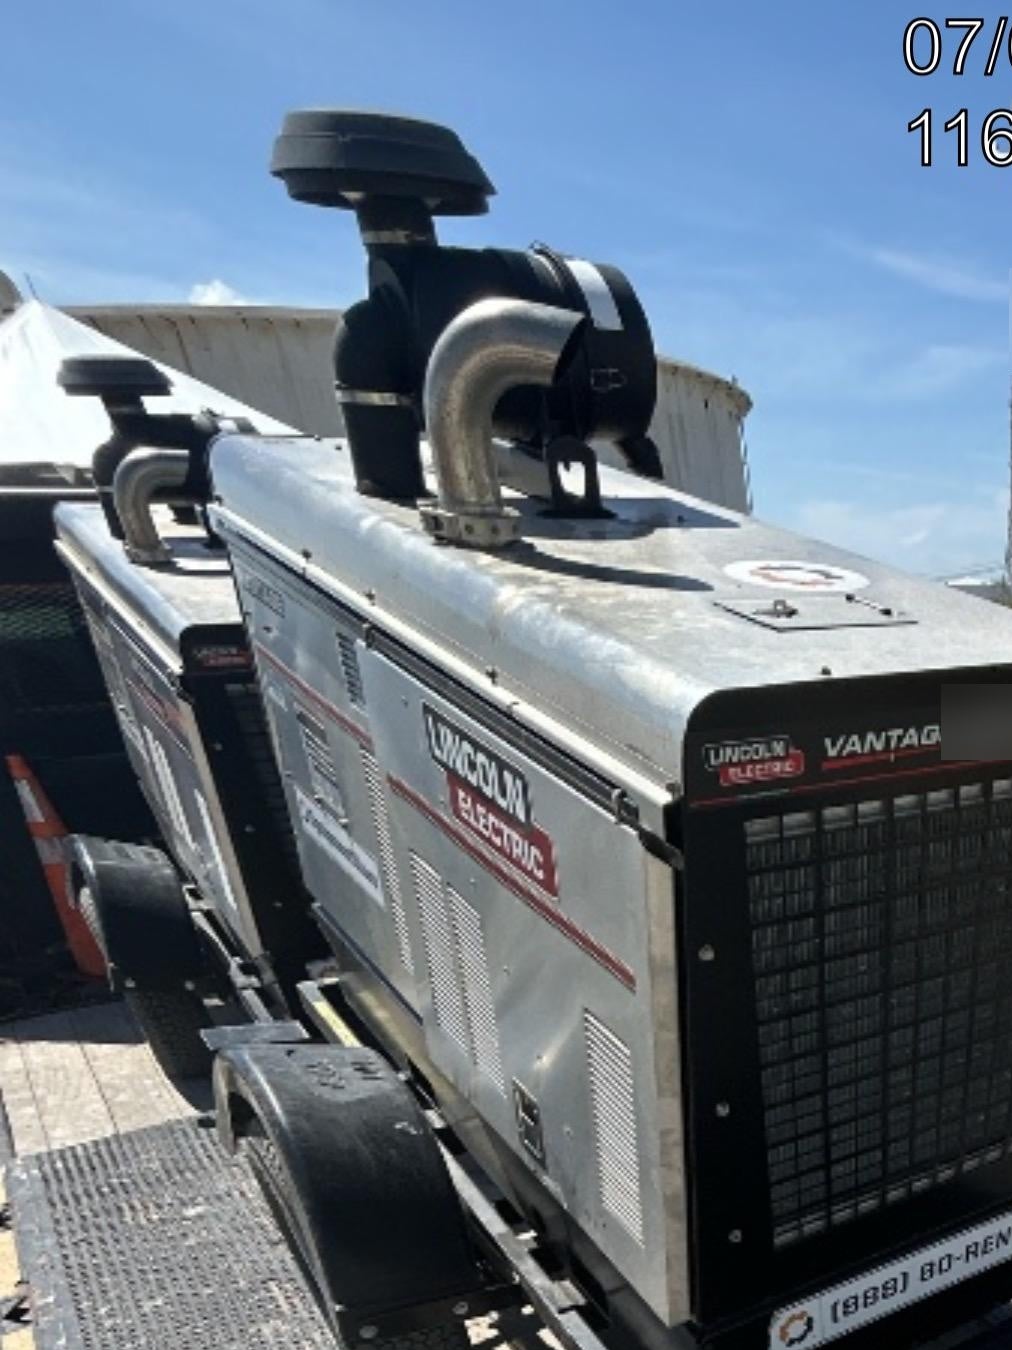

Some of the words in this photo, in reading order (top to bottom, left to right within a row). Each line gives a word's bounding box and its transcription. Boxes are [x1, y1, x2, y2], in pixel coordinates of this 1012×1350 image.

[427, 713, 527, 823] LINCOLN
[709, 739, 787, 767] LINCOLN
[823, 725, 942, 758] VANTAG
[457, 787, 545, 881] ELECTRIC
